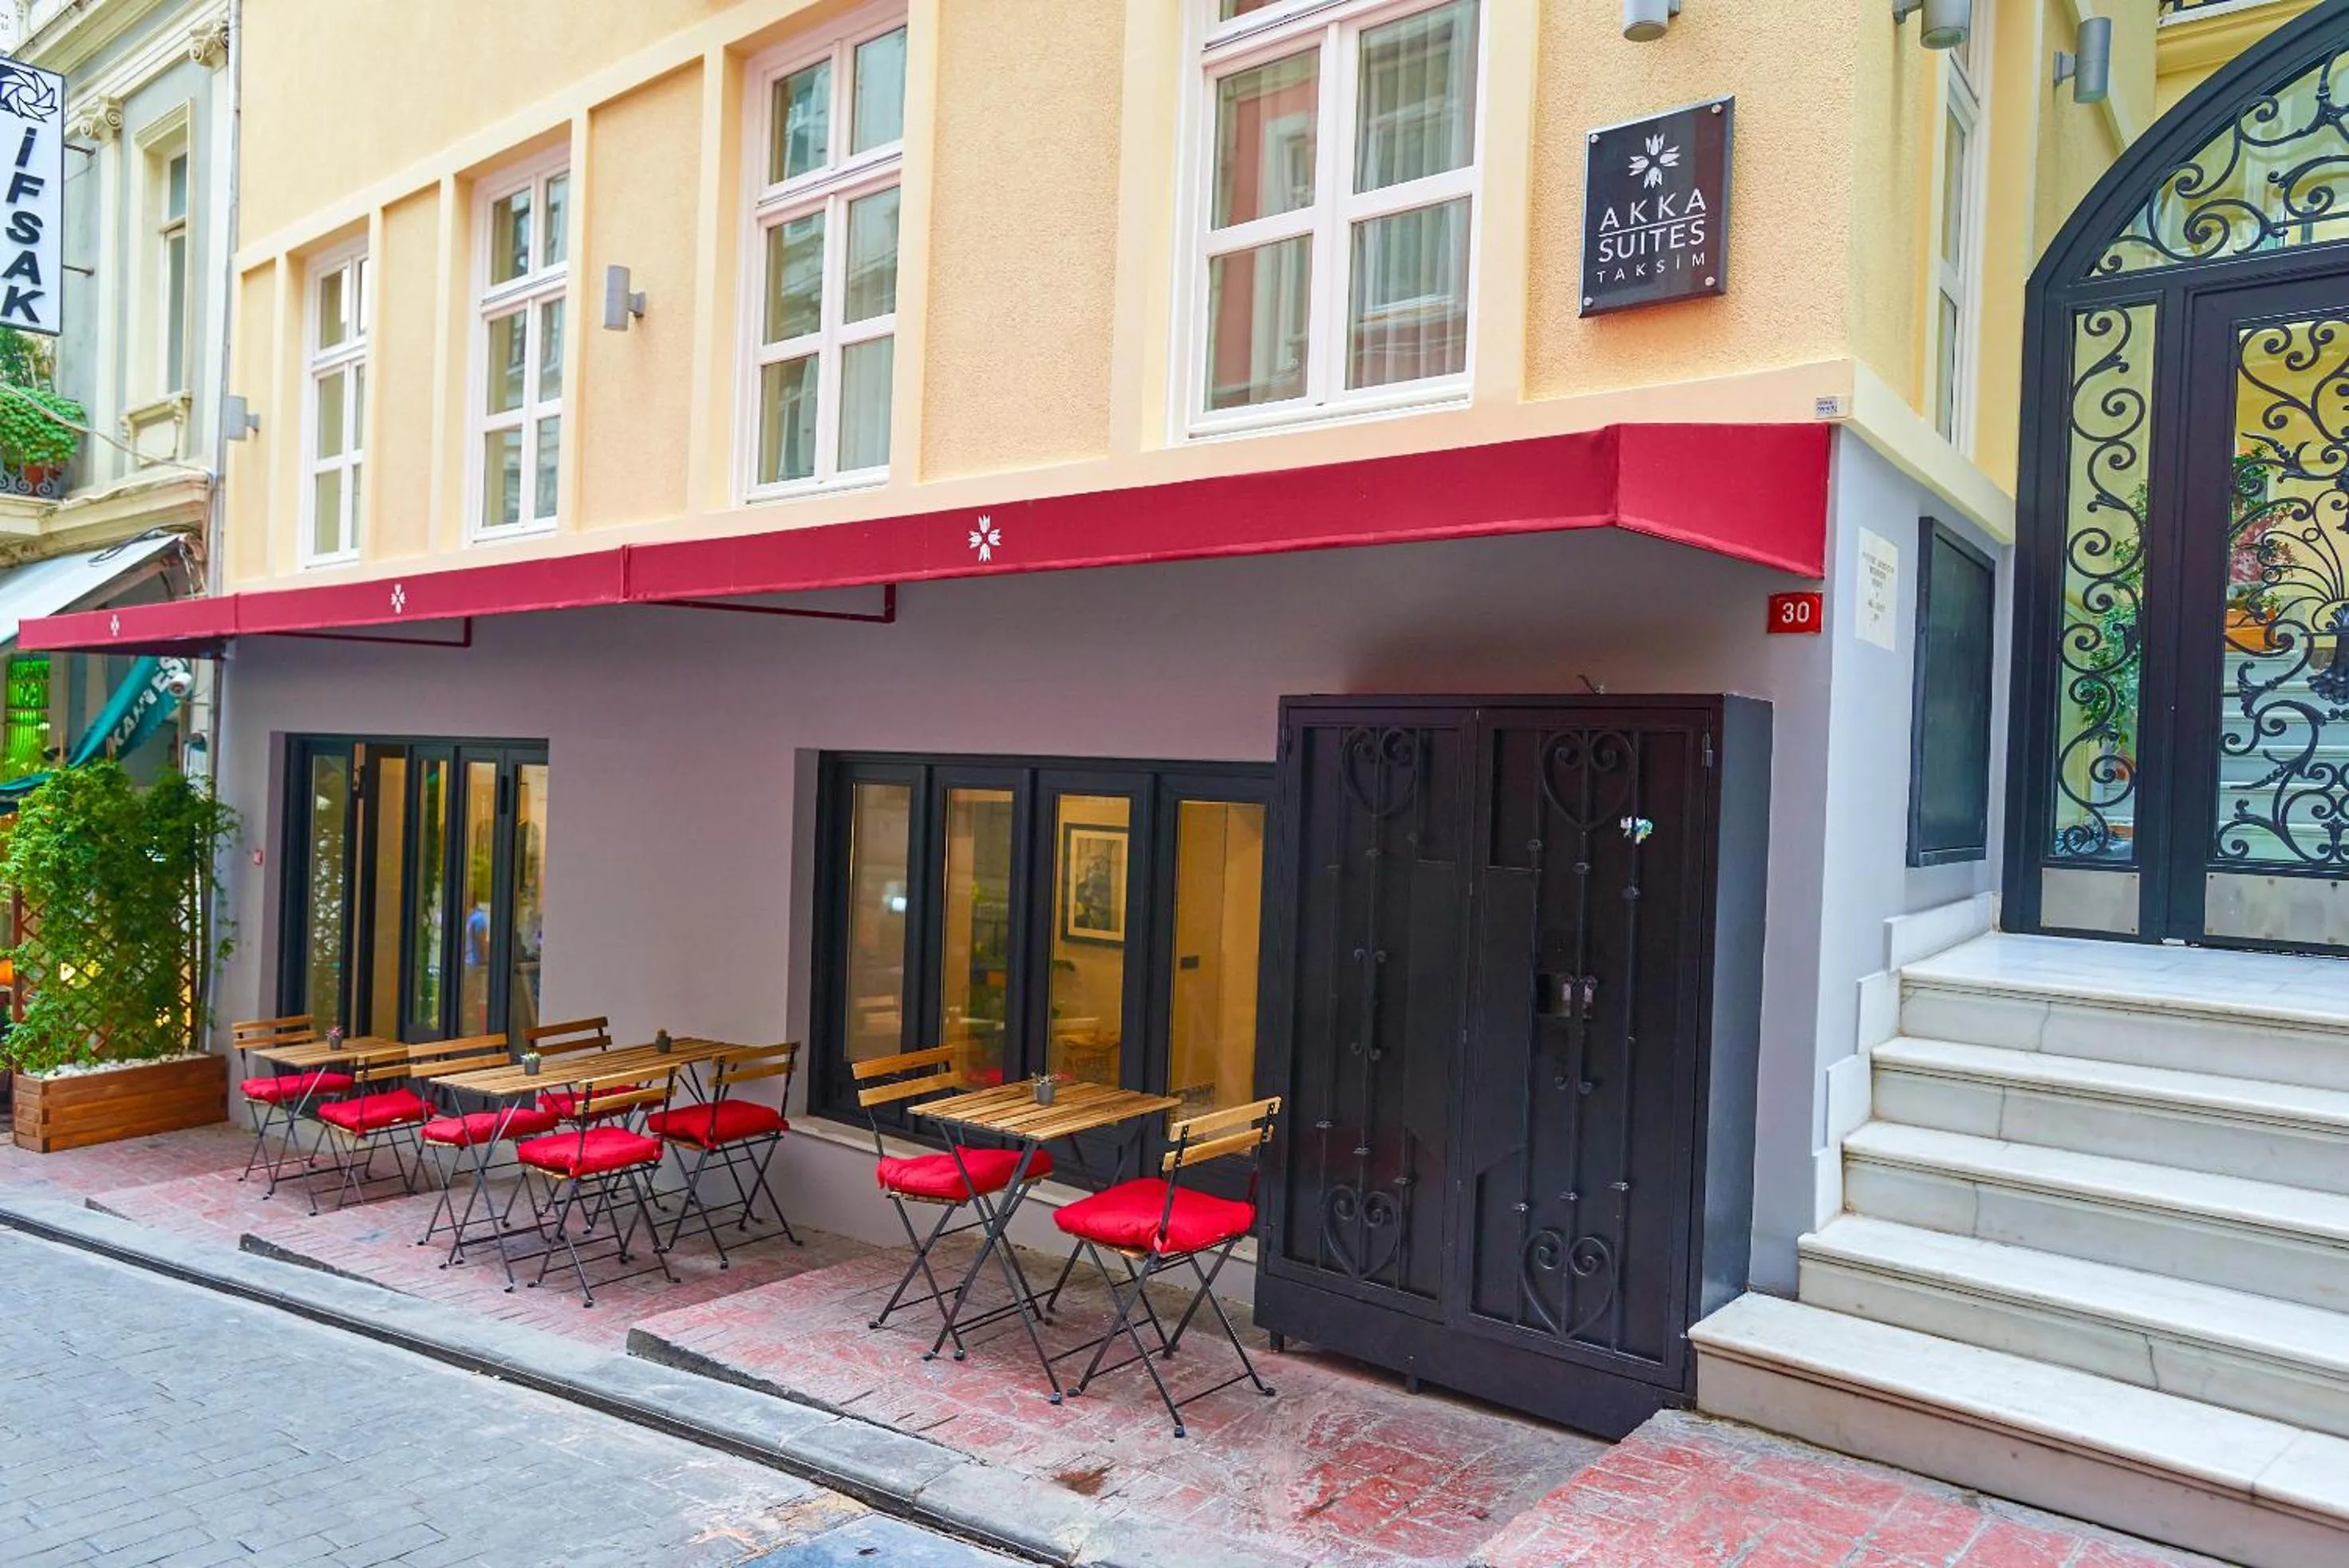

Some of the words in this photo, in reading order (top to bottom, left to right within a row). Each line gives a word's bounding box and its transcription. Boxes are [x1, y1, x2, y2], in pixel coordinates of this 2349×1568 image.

[1600, 188, 1706, 231] AKKA
[1598, 219, 1705, 263] SUITES
[1782, 602, 1810, 623] 30
